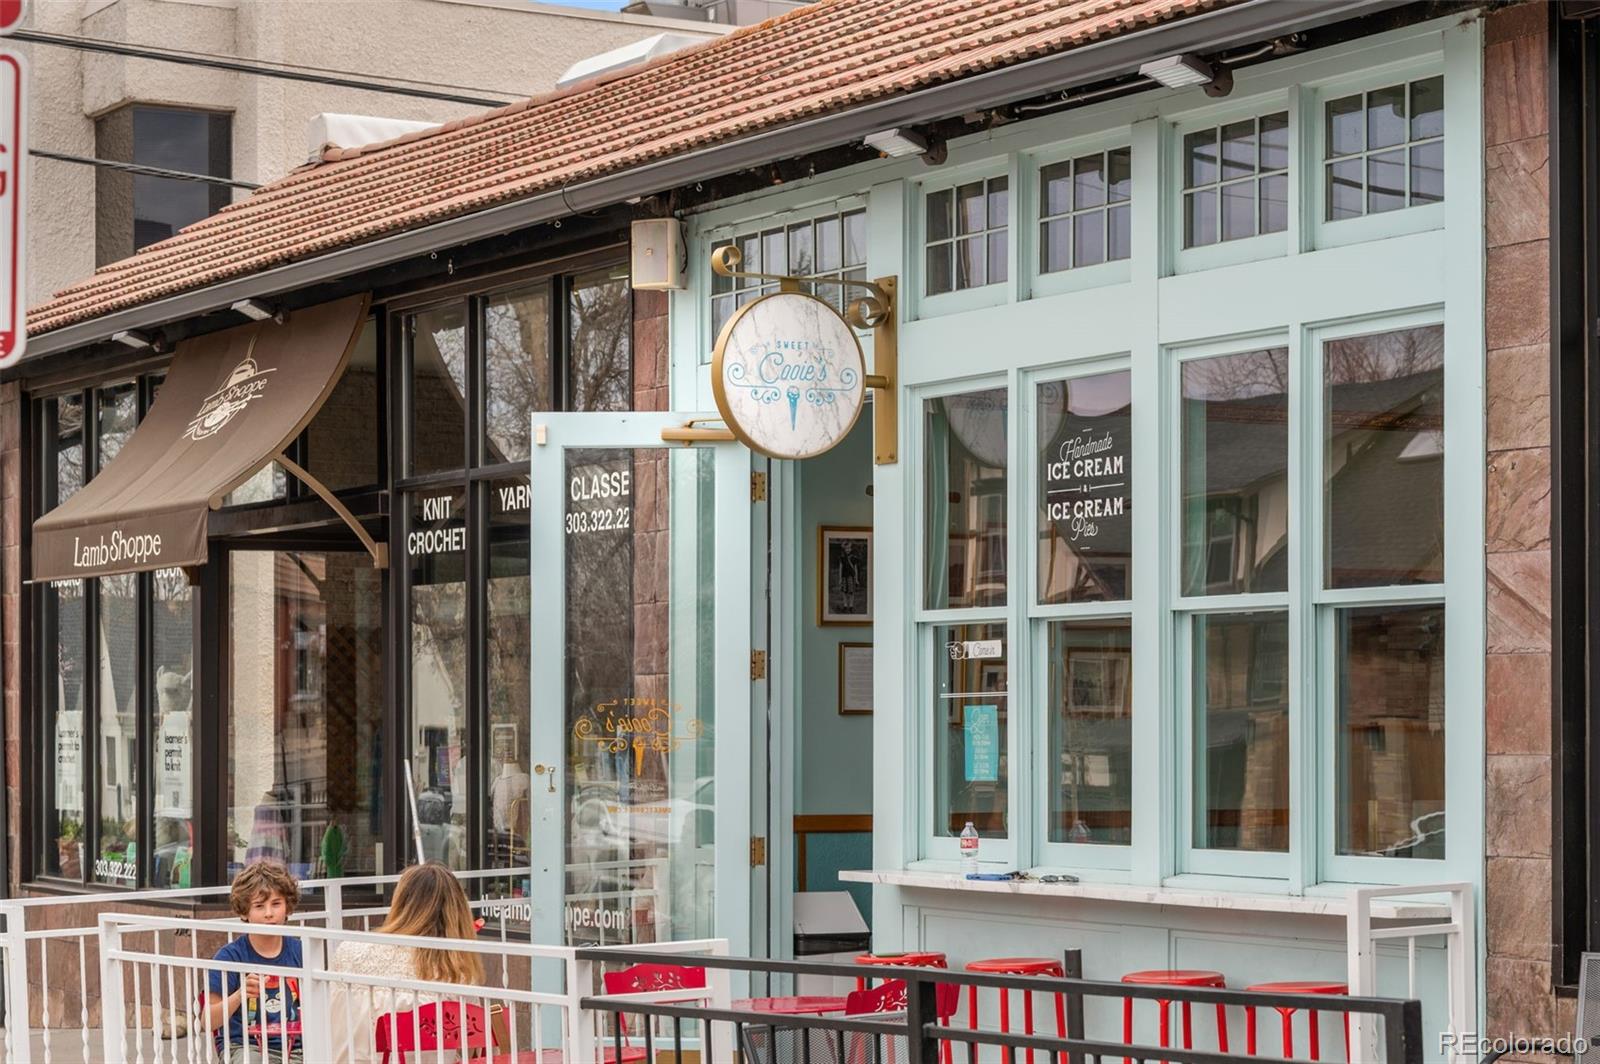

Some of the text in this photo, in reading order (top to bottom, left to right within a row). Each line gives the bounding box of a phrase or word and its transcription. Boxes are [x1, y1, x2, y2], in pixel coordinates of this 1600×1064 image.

[775, 340, 810, 350] SWEET
[759, 351, 828, 385] Cooie's
[1059, 431, 1113, 462] Handmade
[1047, 455, 1124, 481] ICE CREAM
[423, 495, 452, 522] KNIT
[1047, 496, 1124, 521] ICE CREAM
[407, 527, 466, 556] CROCHET
[1070, 516, 1099, 541] Pies
